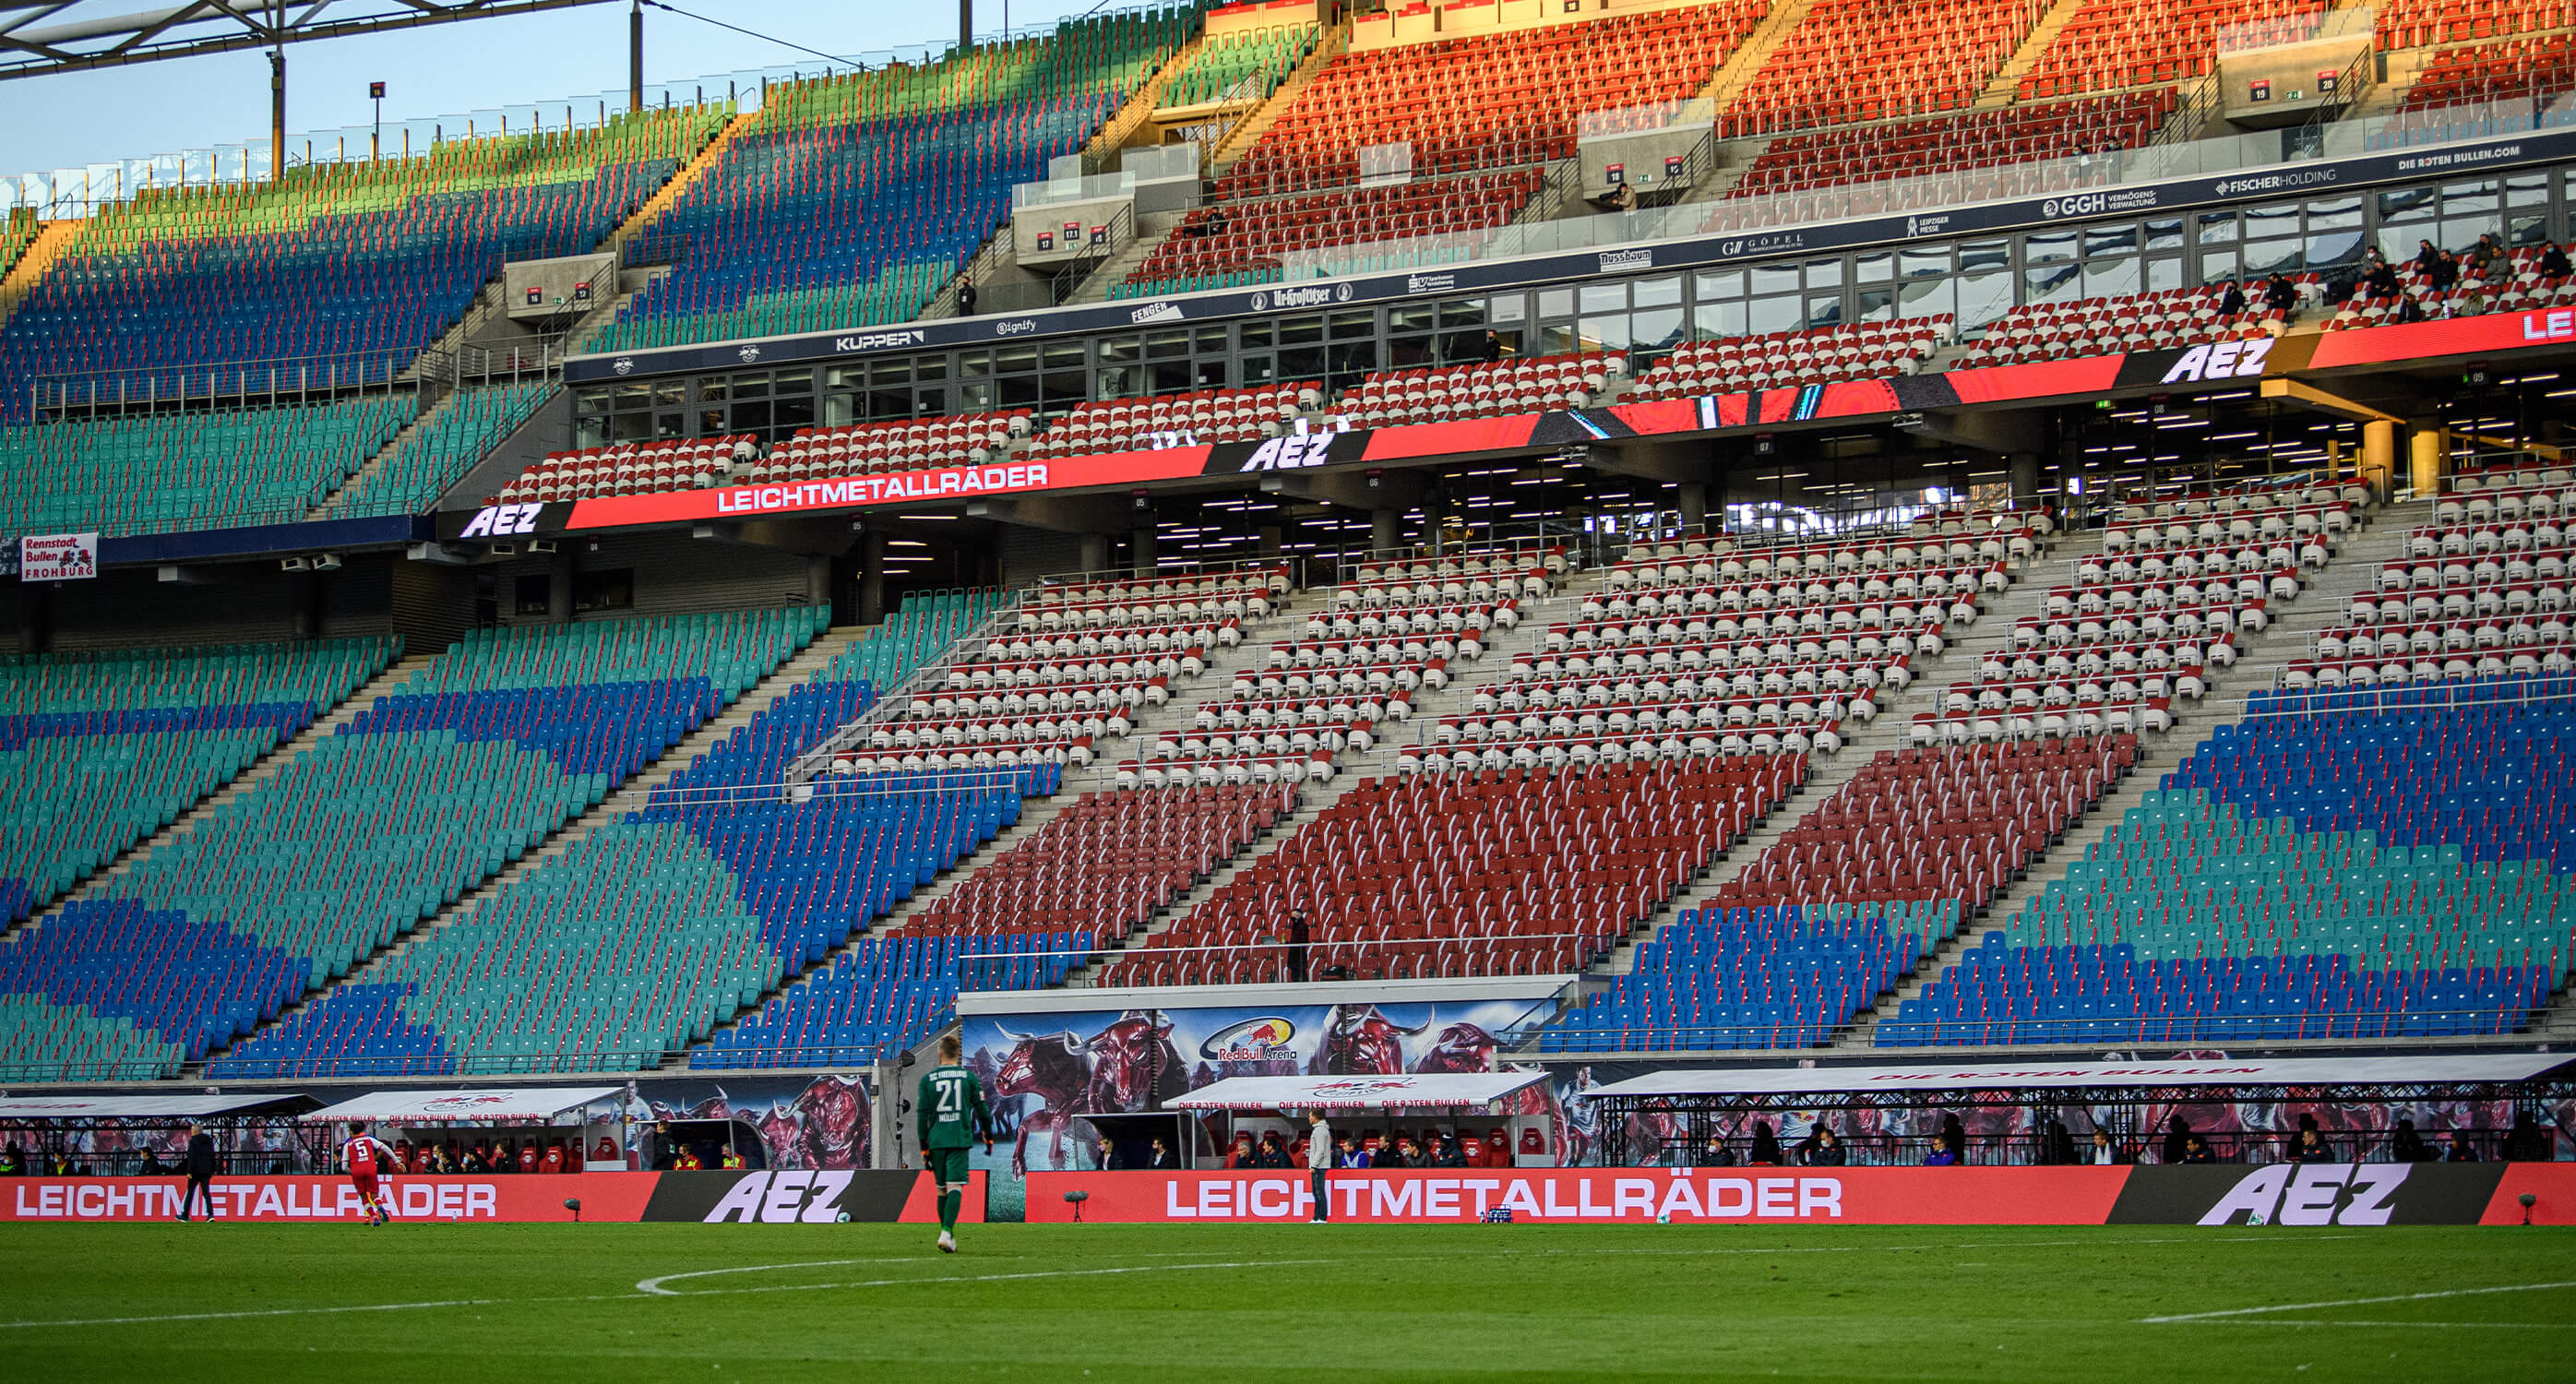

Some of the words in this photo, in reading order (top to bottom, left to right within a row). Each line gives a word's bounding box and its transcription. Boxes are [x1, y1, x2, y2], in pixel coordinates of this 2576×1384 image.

[2322, 79, 2333, 89] 20
[2255, 89, 2266, 100] 19
[2398, 158, 2416, 171] DIE
[2417, 155, 2452, 169] ROTEN
[2453, 145, 2521, 164] BULLEN.COM
[1610, 172, 1620, 182] 18
[2230, 169, 2336, 194] FISCHERHOLDING
[2061, 189, 2105, 215] GGH
[2107, 197, 2156, 210] VERWALTUNG
[1066, 230, 1079, 239] 17.1
[1042, 240, 1050, 249] 17
[836, 331, 912, 352] KUPPER
[2159, 338, 2275, 384] AEZ
[1240, 433, 1335, 471] AEZ
[1759, 442, 1770, 451] 07
[718, 464, 1048, 512] LEICHTMETALLRÄDER
[459, 503, 544, 539] AEZ
[26, 536, 78, 550] Rennstadt
[26, 551, 58, 563] Bullen
[25, 566, 93, 579] FROHBURG
[1219, 1047, 1241, 1060] Red
[1241, 1046, 1263, 1060] Bull
[1264, 1048, 1297, 1060] Arena
[1868, 1072, 1943, 1080] DIE
[2098, 1068, 2265, 1076] BULLEN
[936, 1079, 961, 1112] 21
[1279, 1101, 1295, 1109] DIE
[354, 1140, 368, 1157] 5
[16, 1175, 496, 1217] LEICHTMETALLRÄDER
[703, 1170, 855, 1223] AEZ
[1167, 1167, 1842, 1217] LEICHTMETALLRÄDER
[2196, 1163, 2415, 1225] AEZ
